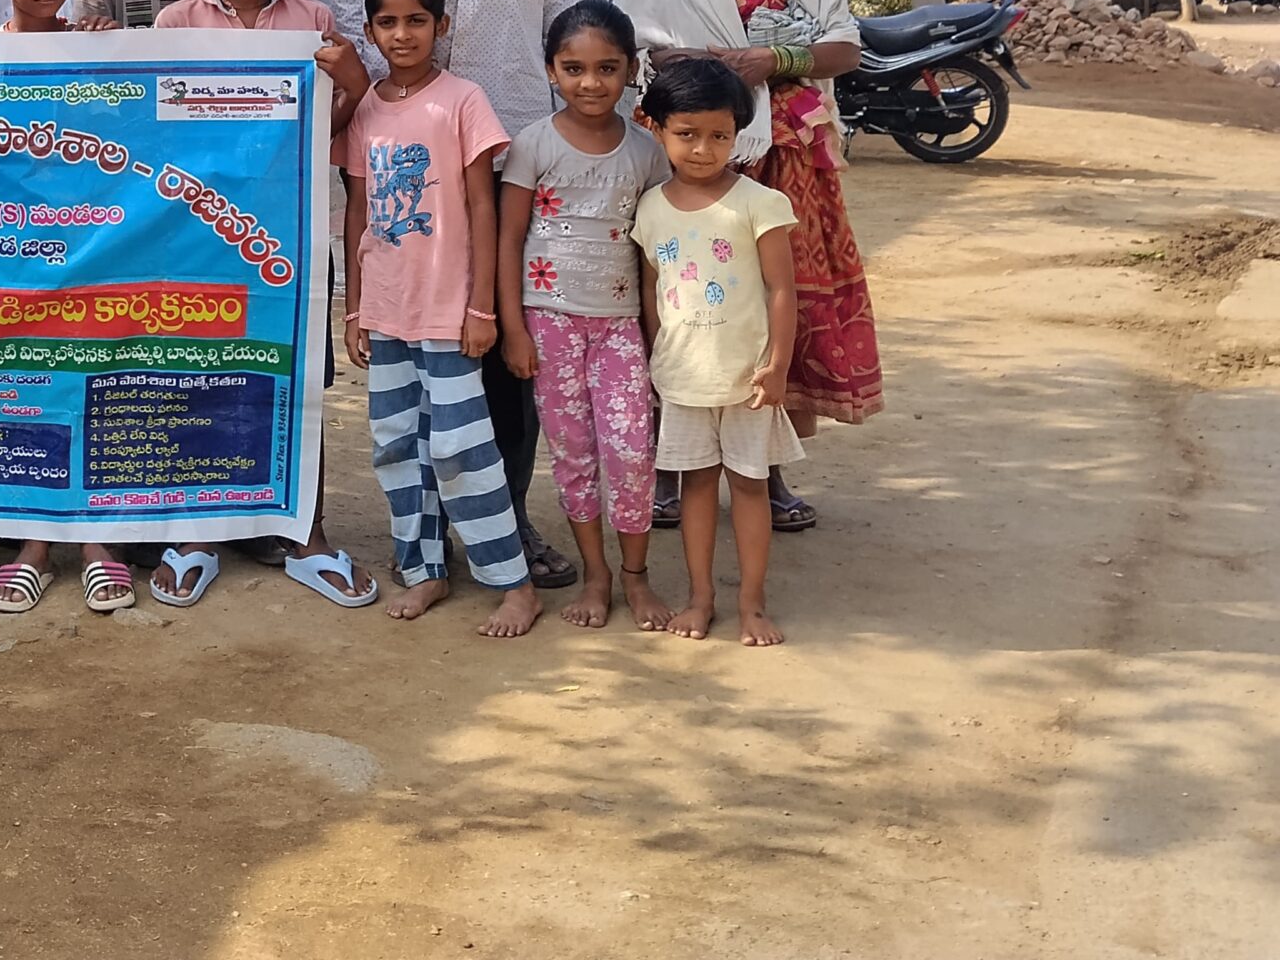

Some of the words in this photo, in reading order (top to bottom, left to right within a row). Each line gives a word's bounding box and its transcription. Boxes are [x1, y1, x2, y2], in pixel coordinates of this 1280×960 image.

[64, 82, 145, 104] ప్రభుత్వము
[217, 87, 235, 95] మా
[29, 204, 125, 227] మండలం
[156, 163, 294, 287] రాజవరం
[20, 236, 67, 265] జిల్లా
[94, 292, 242, 334] కార్యక్రమం
[221, 343, 280, 364] చేయండి
[91, 378, 117, 389] మన
[119, 375, 177, 388] పాఠశాల
[91, 407, 101, 416] 2.
[90, 419, 101, 428] 3.
[90, 433, 100, 442] 4.
[90, 447, 100, 456] 5.
[90, 476, 100, 484] 7.
